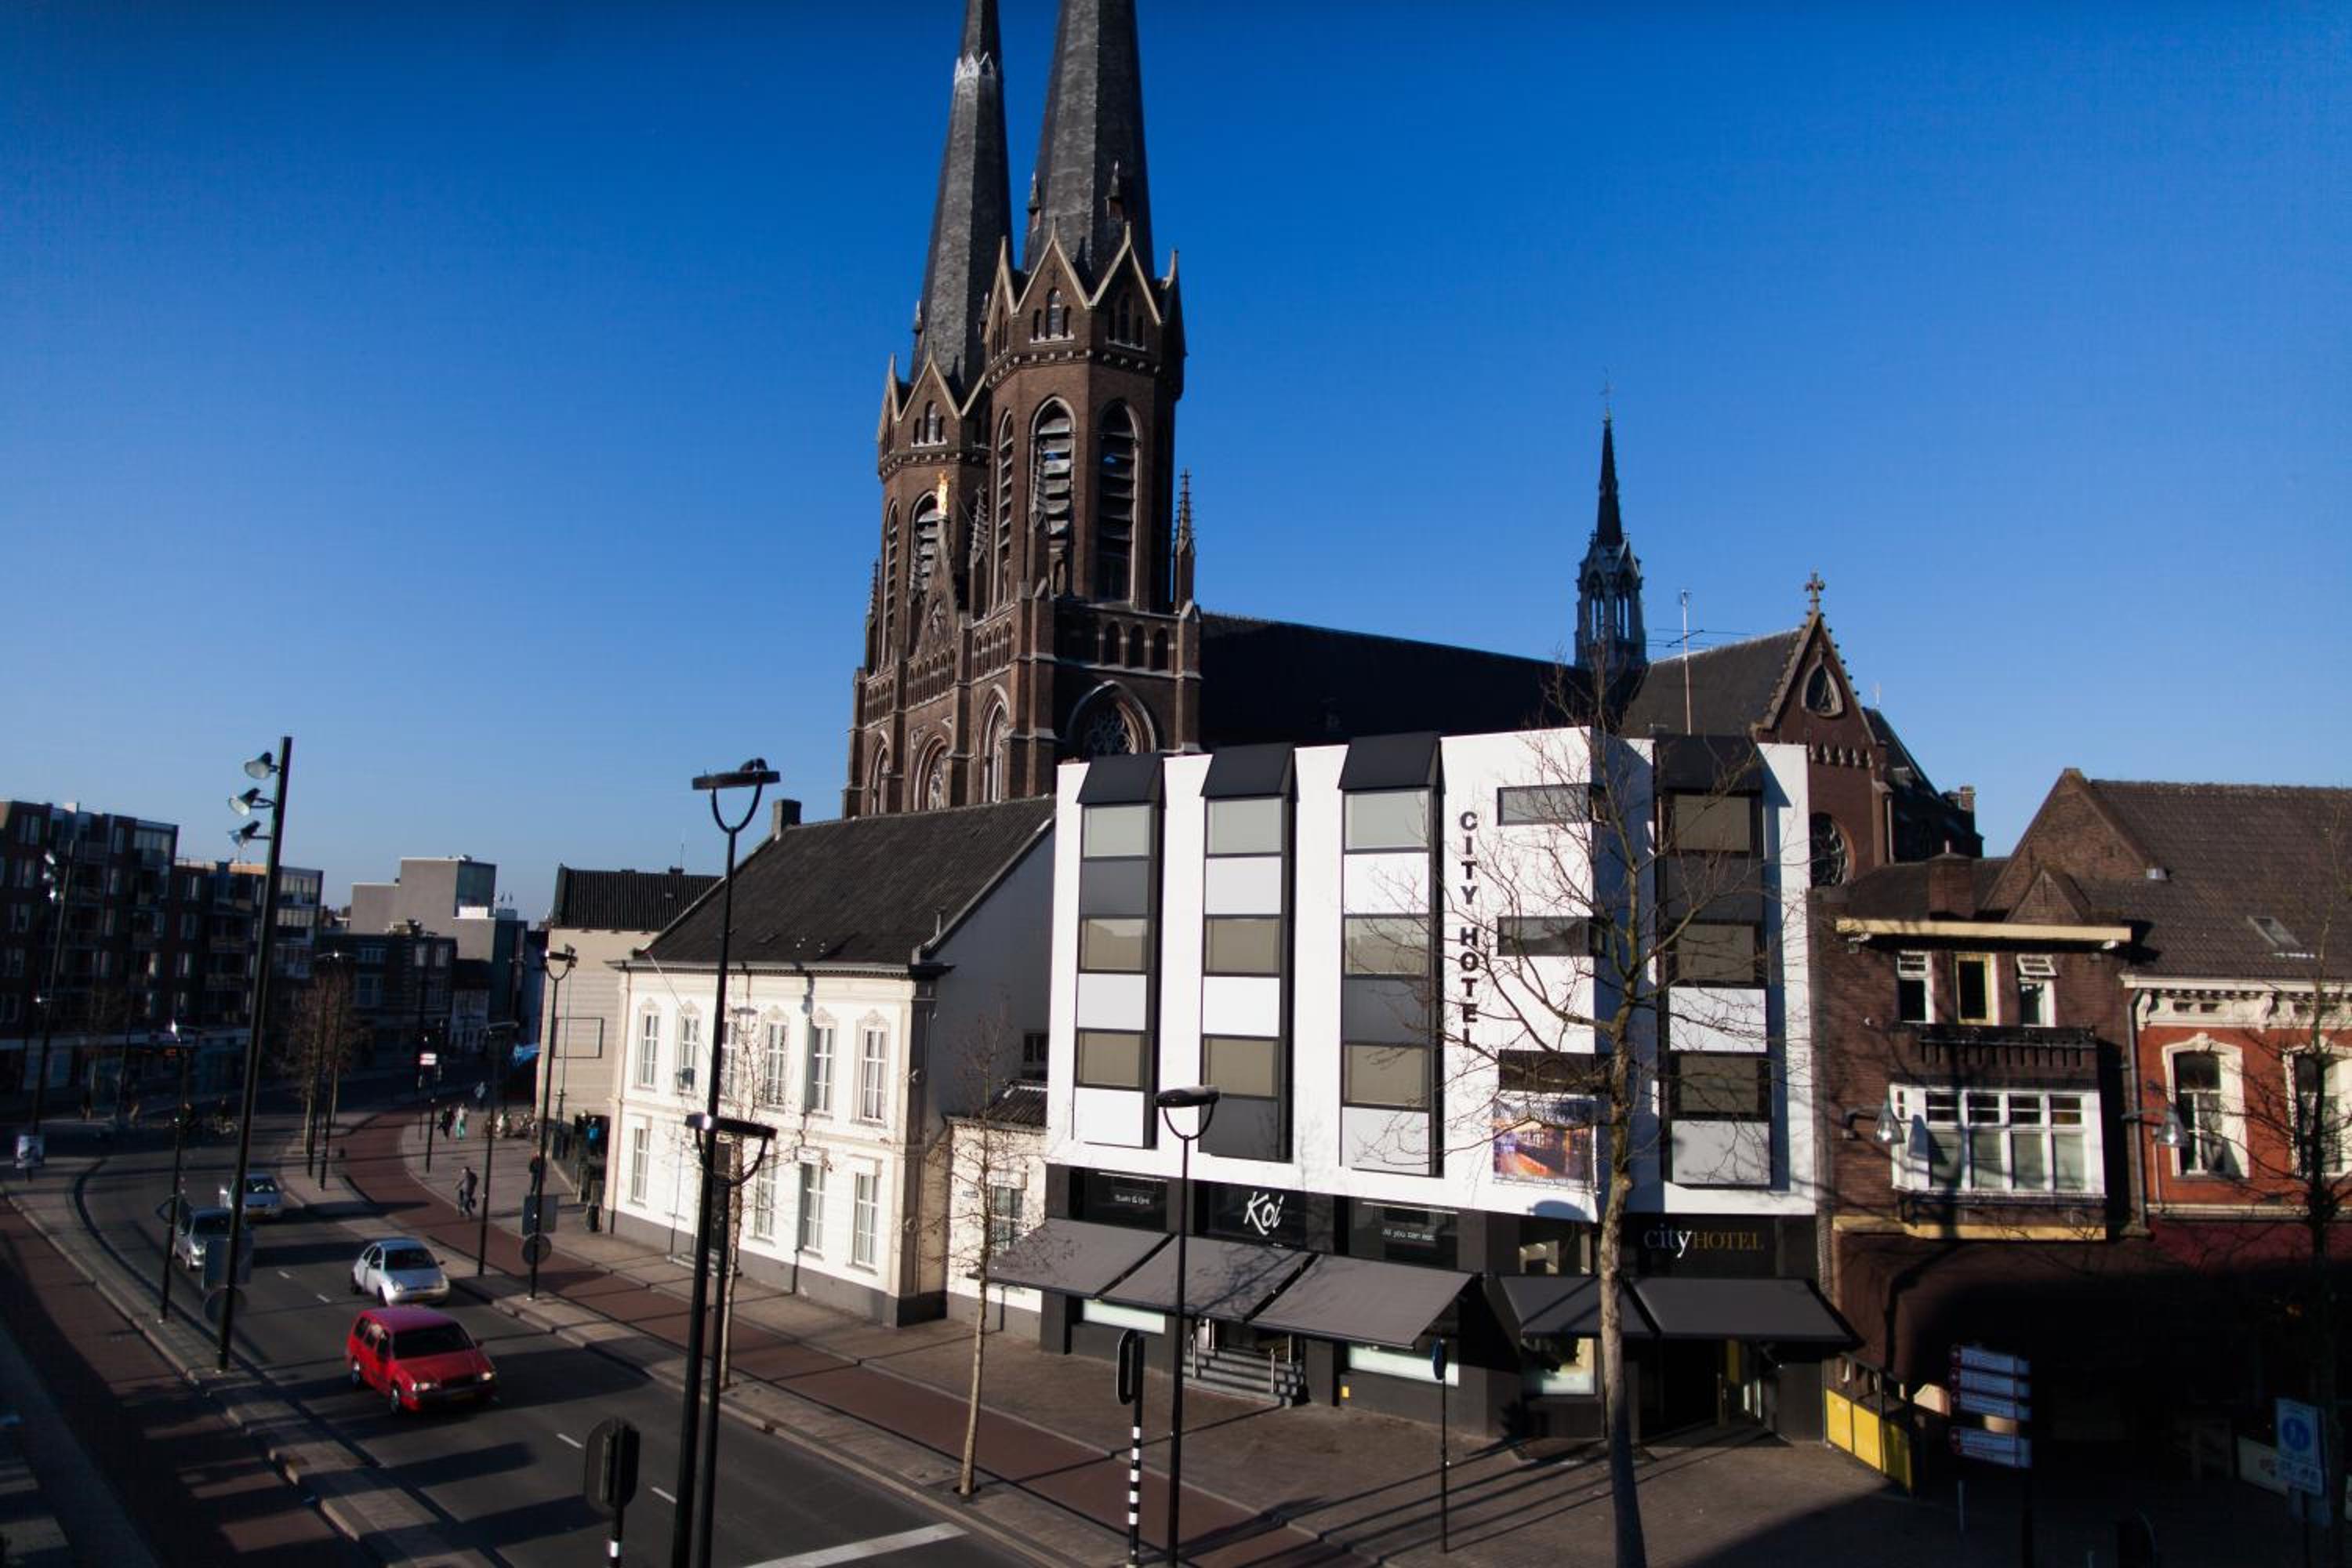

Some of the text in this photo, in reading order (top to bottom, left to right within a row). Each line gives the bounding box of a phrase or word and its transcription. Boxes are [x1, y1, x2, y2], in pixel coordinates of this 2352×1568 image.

[1460, 811, 1479, 1048] CITY HOTEL
[1243, 1191, 1285, 1236] Koi
